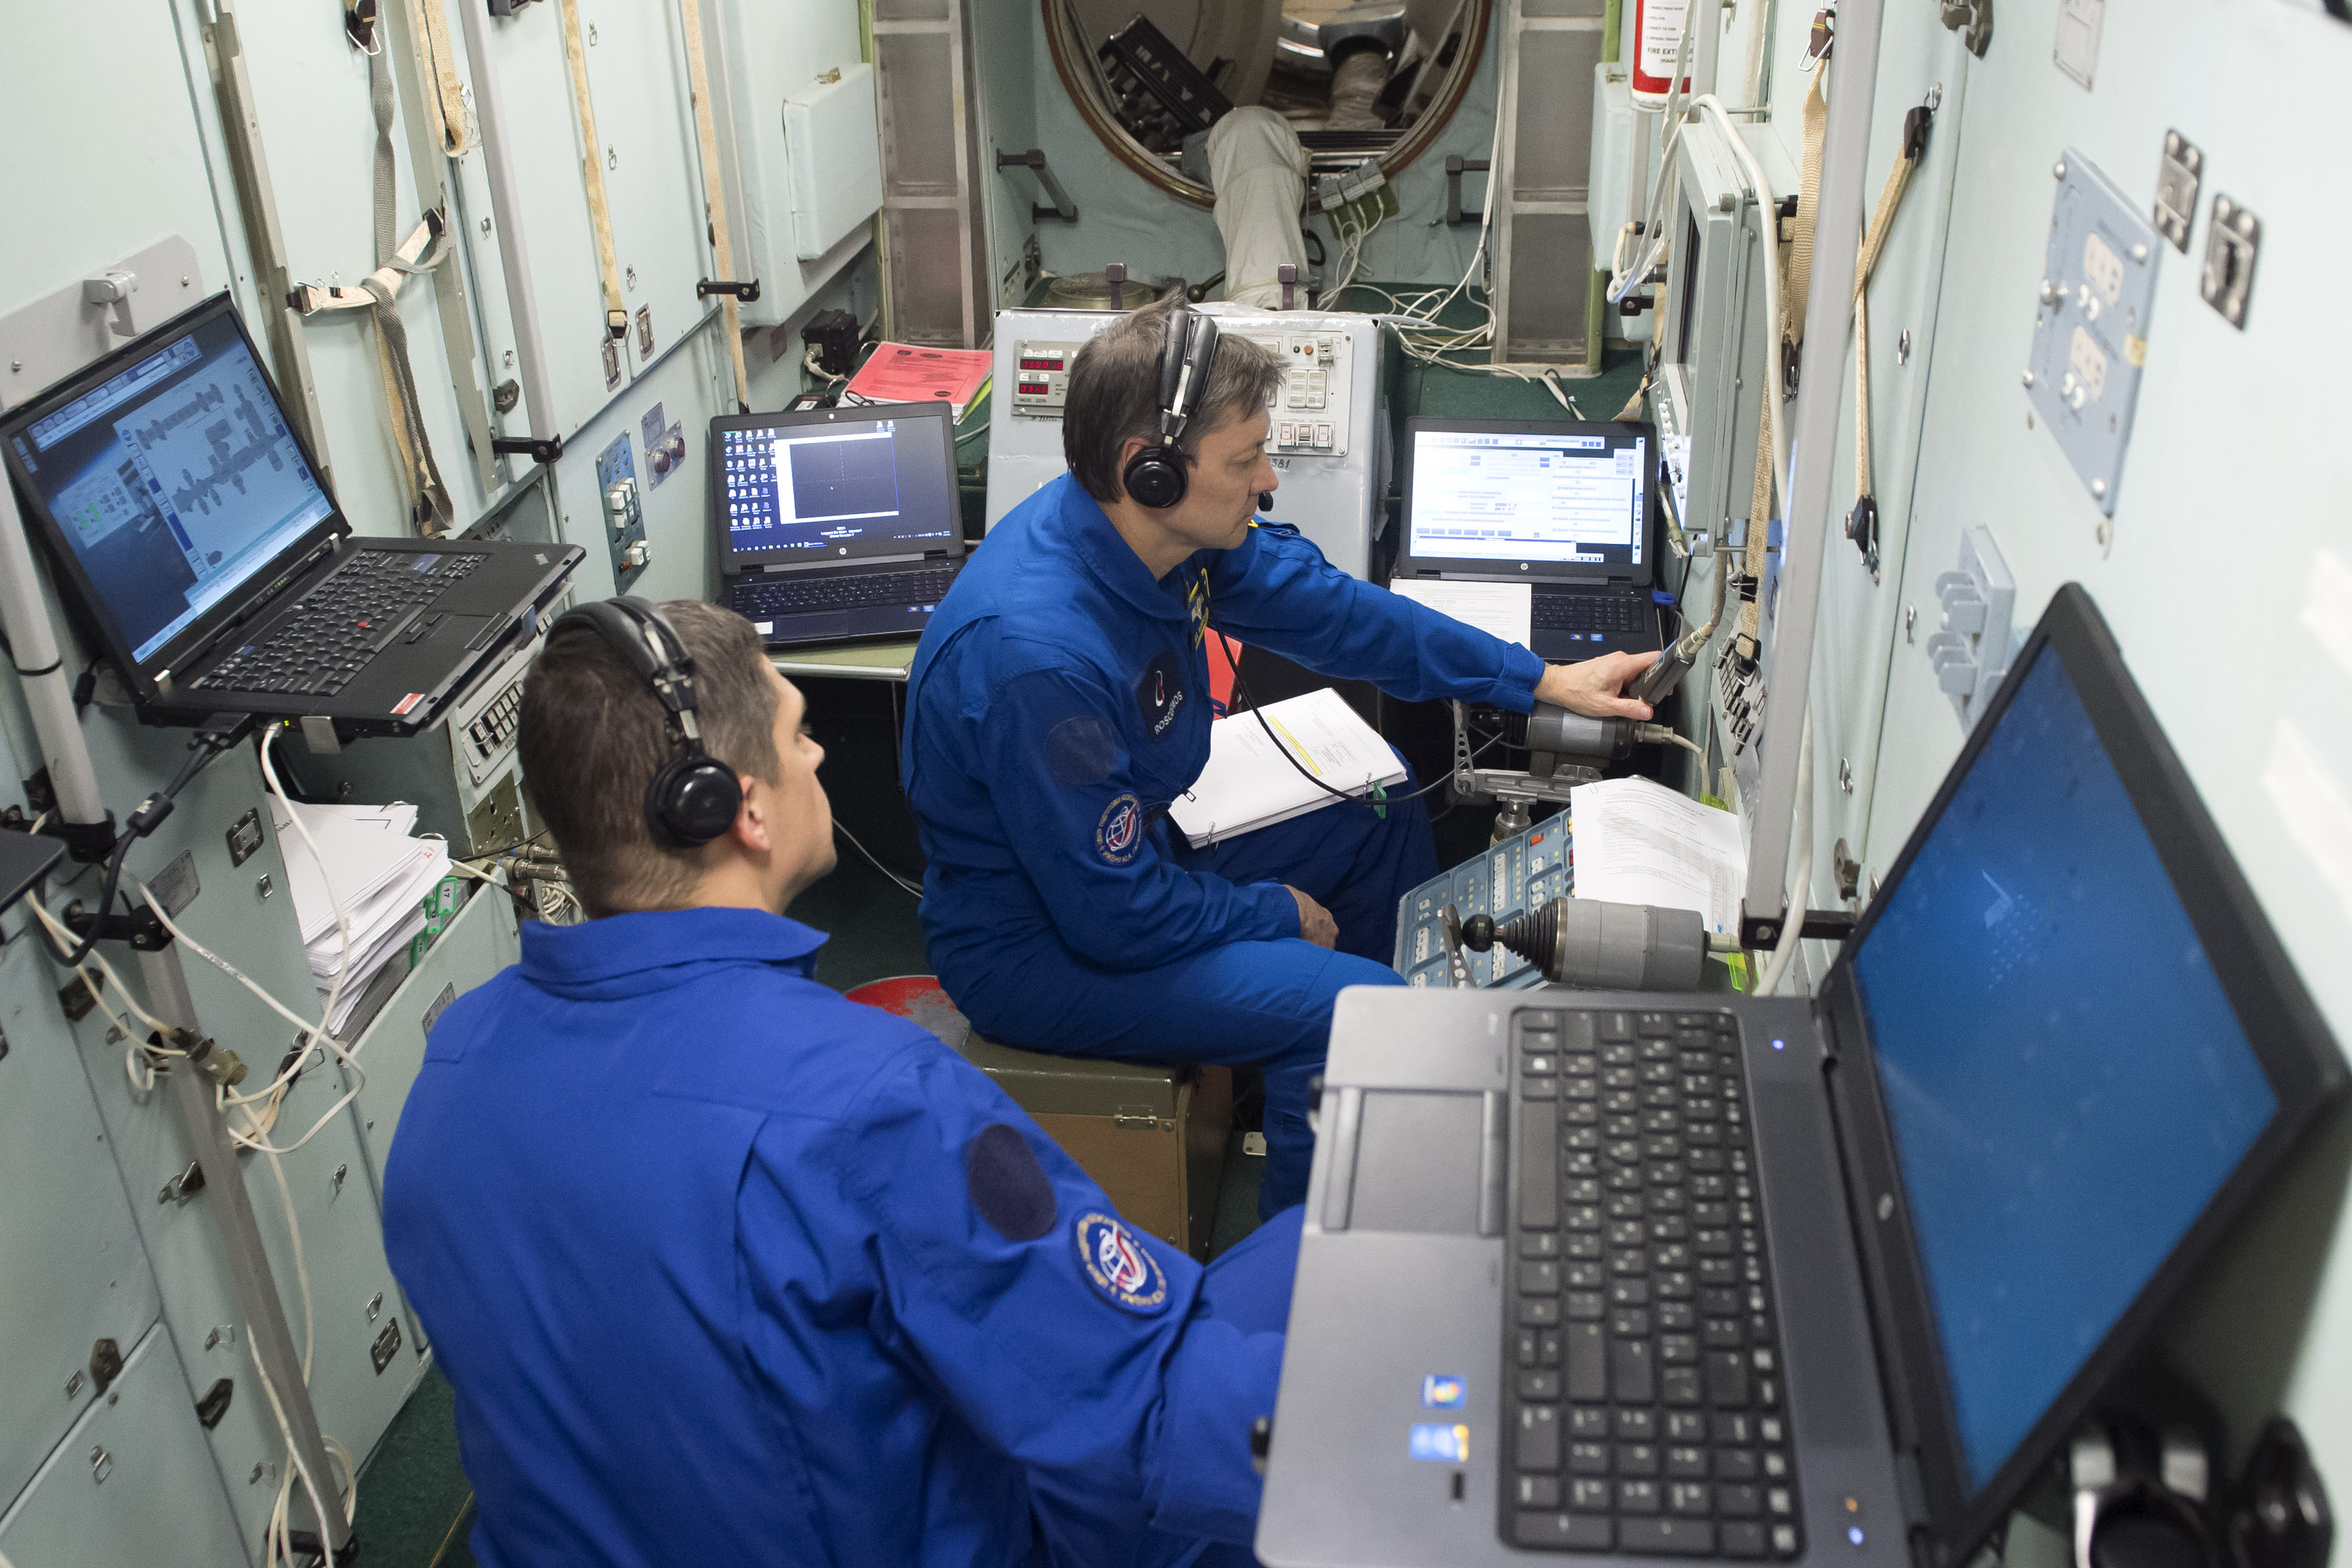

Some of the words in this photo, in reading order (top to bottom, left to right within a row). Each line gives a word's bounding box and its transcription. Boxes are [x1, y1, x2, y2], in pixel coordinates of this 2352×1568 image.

[1269, 458, 1290, 469] 381
[1154, 691, 1183, 735] ROSCOSMOS
[444, 887, 451, 898] 17
